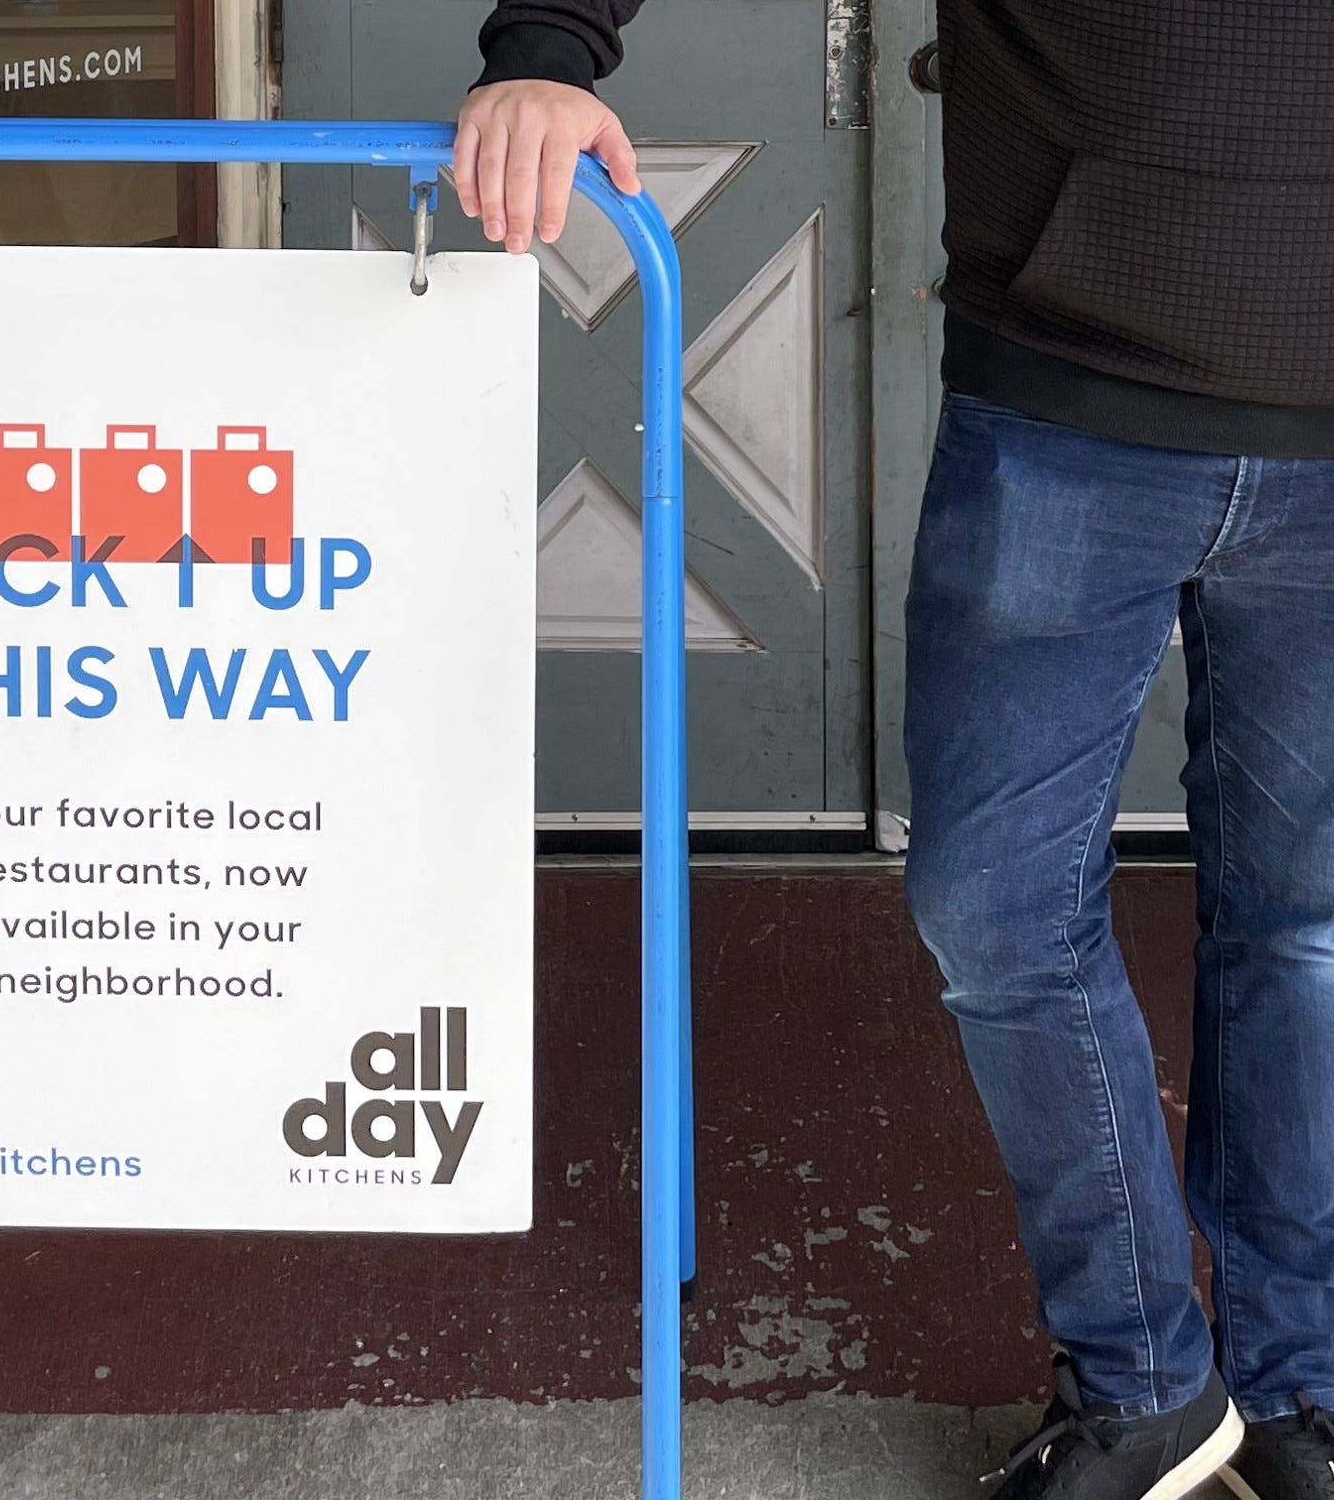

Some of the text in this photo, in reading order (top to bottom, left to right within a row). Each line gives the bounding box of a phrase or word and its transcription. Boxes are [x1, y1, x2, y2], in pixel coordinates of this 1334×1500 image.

[251, 537, 373, 611] UP
[149, 646, 371, 723] WAY
[57, 798, 215, 831] favorite
[229, 800, 322, 832] local
[225, 865, 308, 887] now
[169, 912, 200, 941] in
[215, 921, 303, 950] your
[350, 1006, 468, 1093] all
[282, 1081, 484, 1185] day
[289, 1168, 422, 1186] KITCHENS
